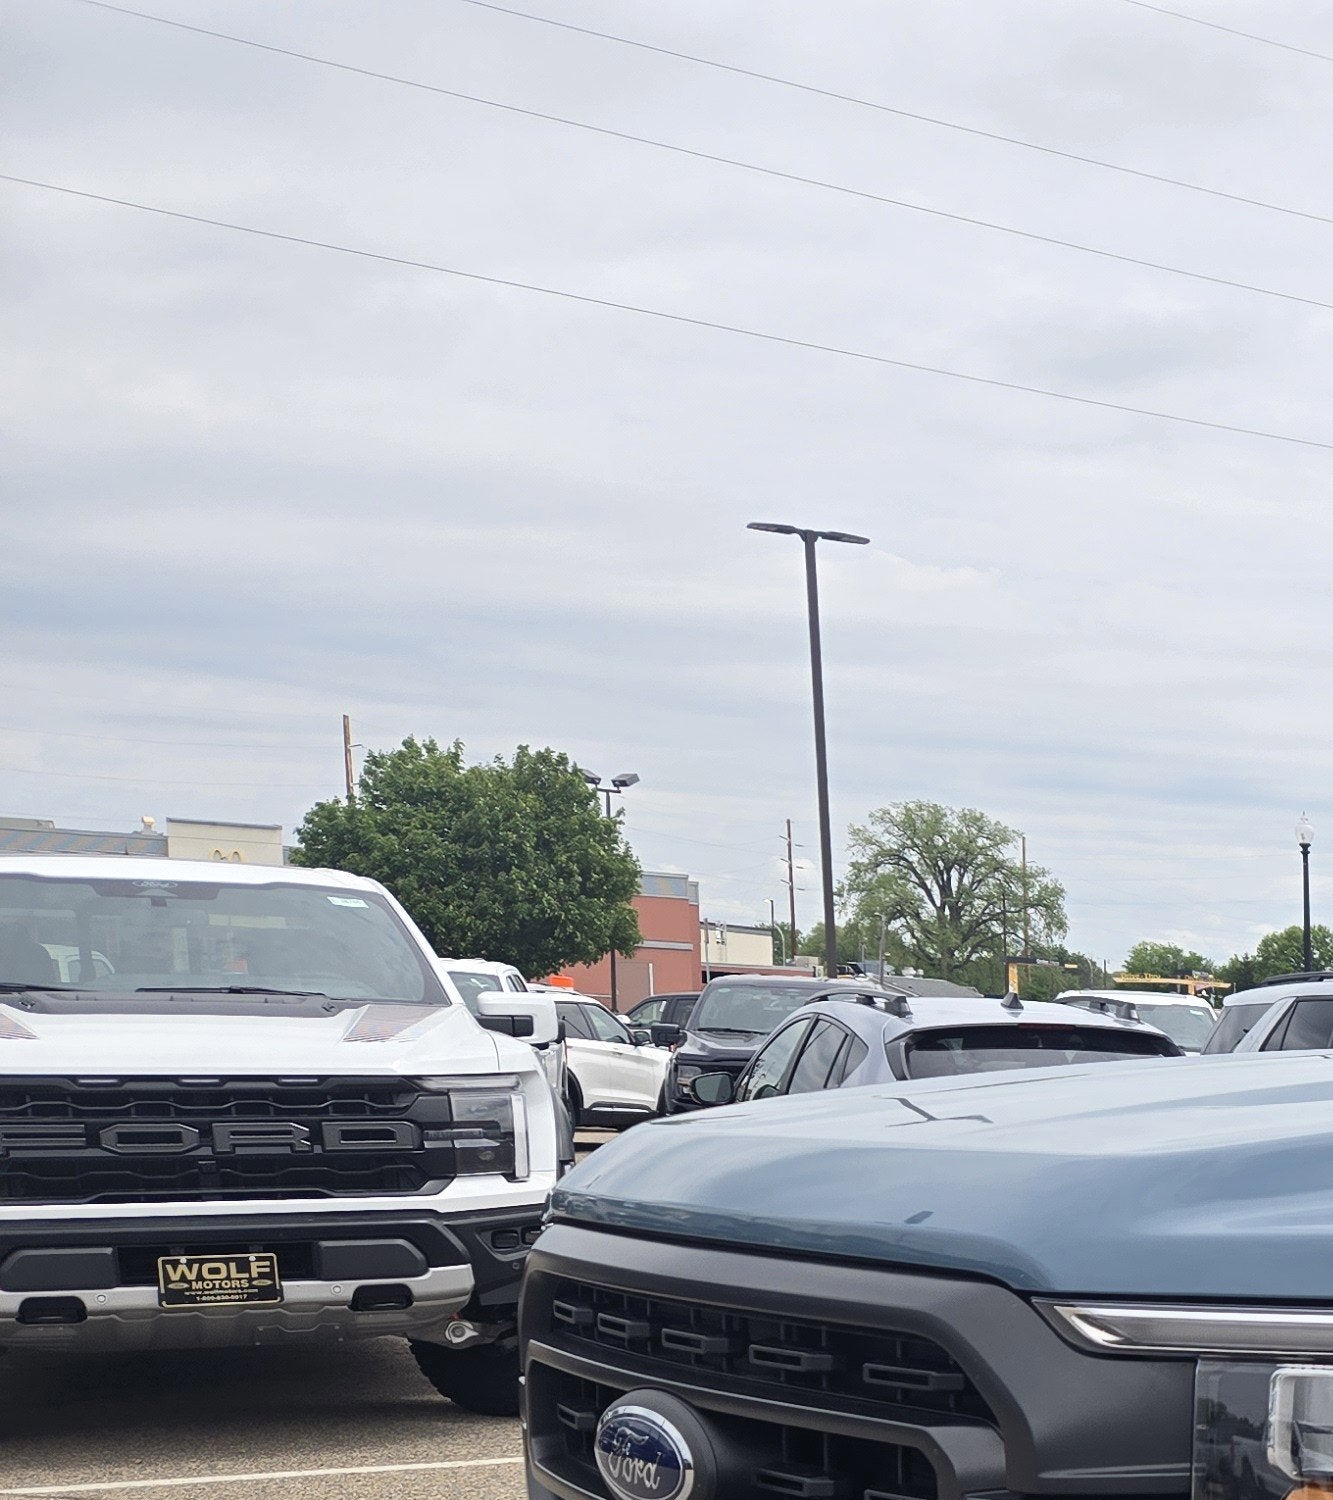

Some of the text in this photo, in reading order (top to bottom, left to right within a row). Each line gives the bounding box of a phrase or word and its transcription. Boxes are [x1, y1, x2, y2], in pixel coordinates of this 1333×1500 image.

[165, 1261, 271, 1281] WOLF
[191, 1279, 250, 1290] MOTORS
[607, 1426, 662, 1490] Ford
